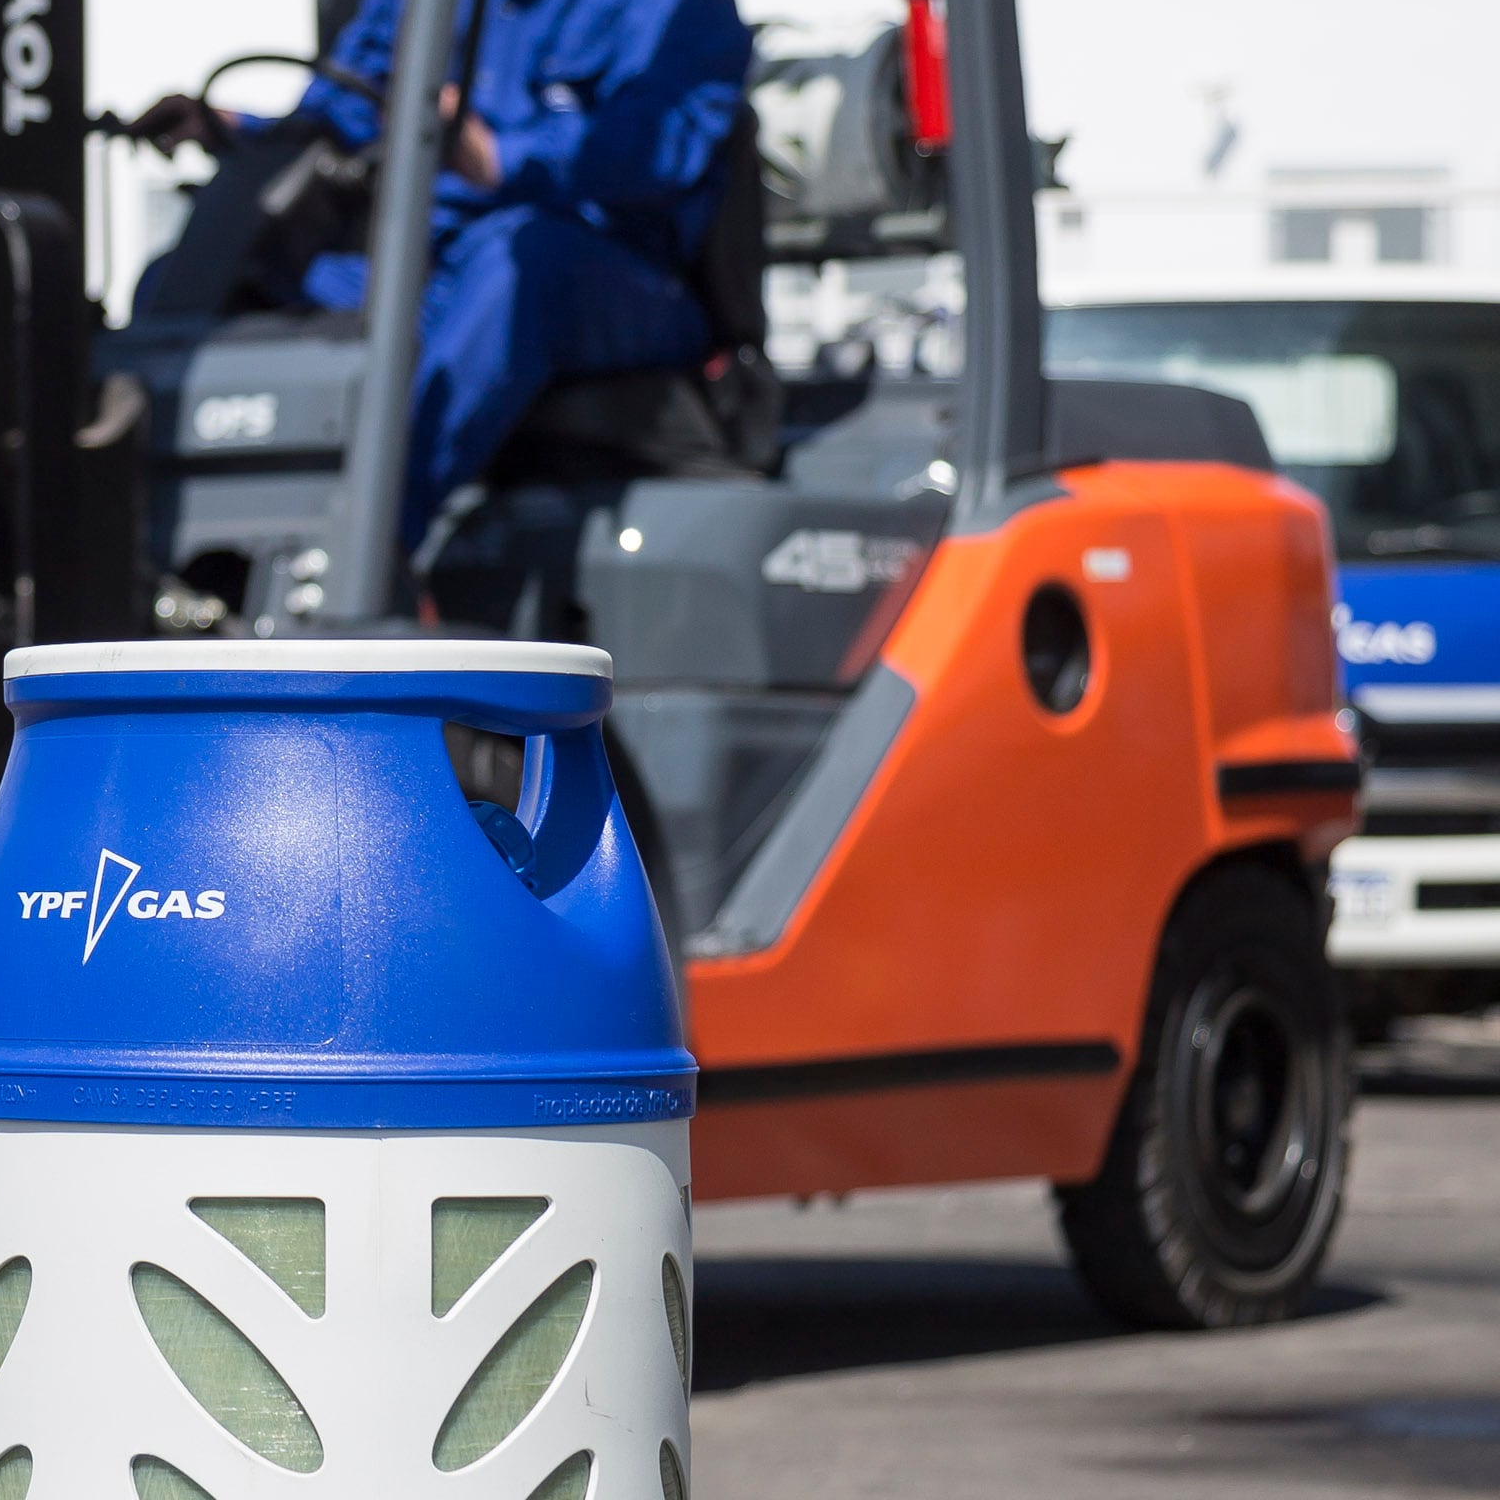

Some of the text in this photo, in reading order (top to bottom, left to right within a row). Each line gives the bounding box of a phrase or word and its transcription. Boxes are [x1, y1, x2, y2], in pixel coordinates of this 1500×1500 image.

[762, 529, 864, 592] 45
[1337, 620, 1436, 664] GAS
[17, 890, 226, 919] YPF GAS
[73, 1086, 127, 1106] CAMISA
[135, 1088, 156, 1107] DE
[533, 1092, 622, 1120] Propiedad
[625, 1089, 643, 1113] de
